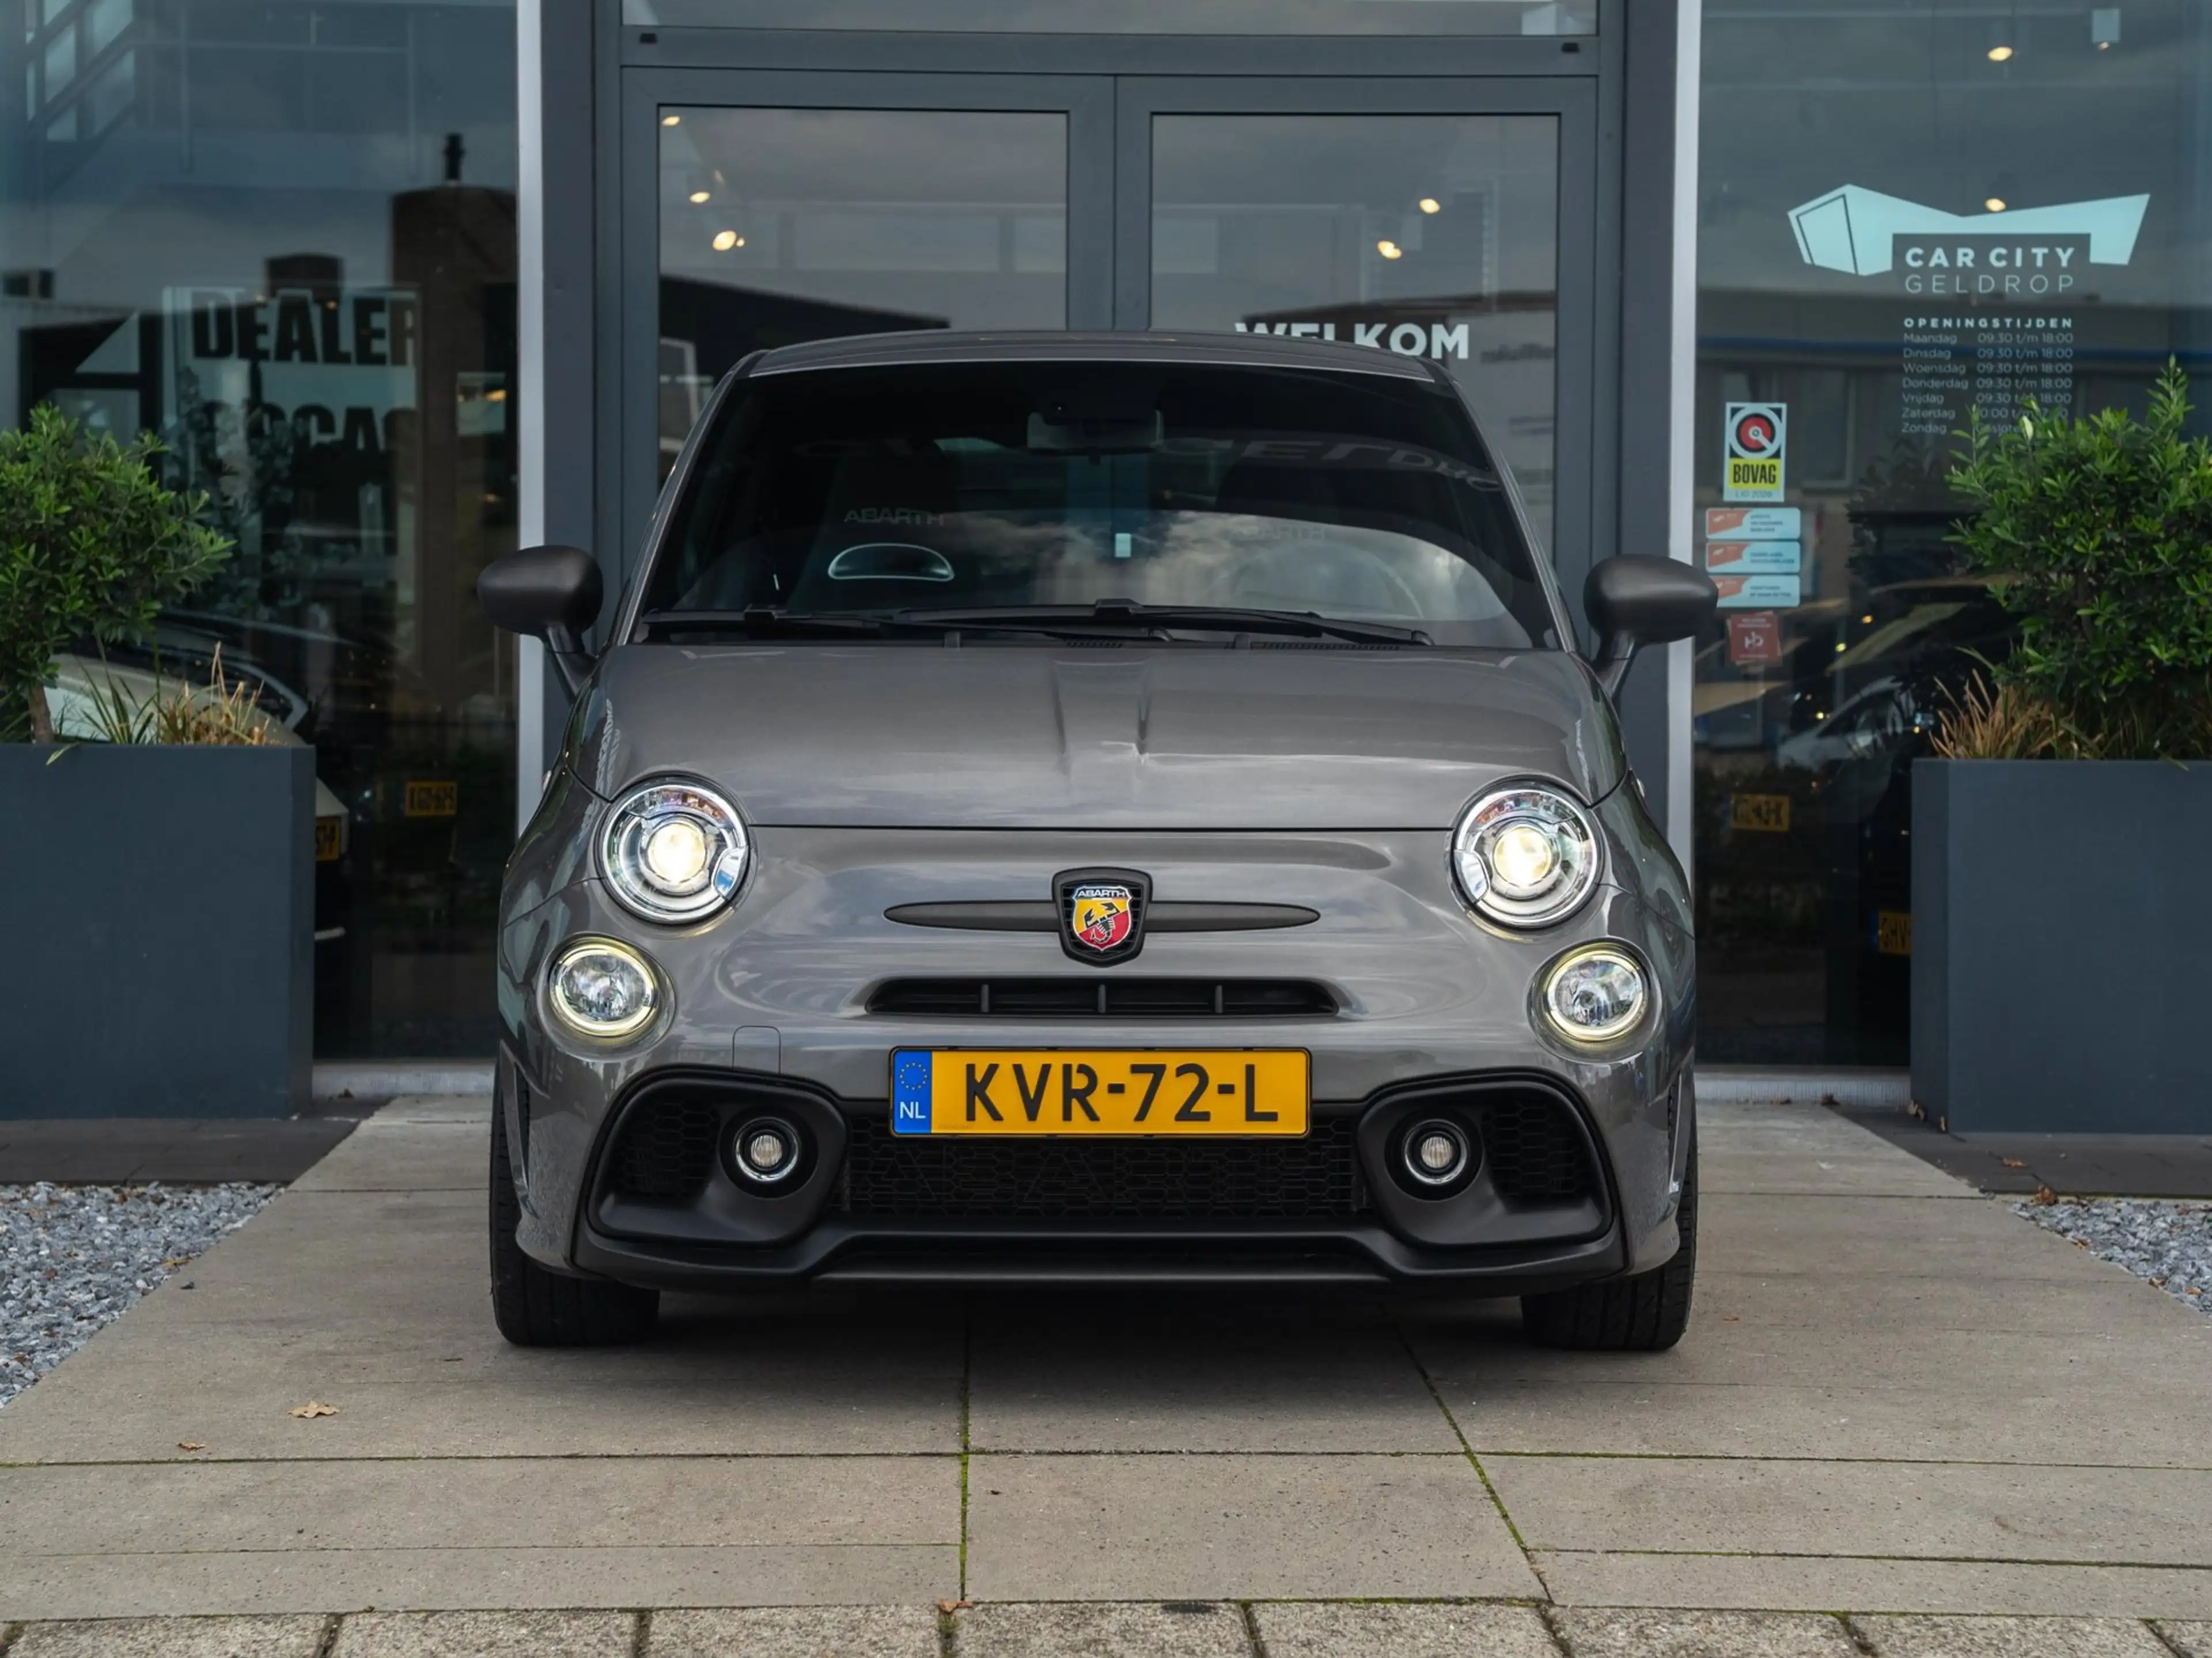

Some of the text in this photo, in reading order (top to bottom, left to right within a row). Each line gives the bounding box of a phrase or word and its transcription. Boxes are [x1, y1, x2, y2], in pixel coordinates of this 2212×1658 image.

[1905, 247, 2074, 268] CAR CITY
[1905, 274, 2074, 293] GELDROP
[1903, 318, 2073, 328] OPENINGSTIJDEN
[1234, 323, 1469, 359] KOM
[1903, 332, 1958, 345] Maandag
[2016, 331, 2039, 344] t/m
[1903, 347, 1952, 360] Dinsdag
[2016, 347, 2038, 359] t/m
[1902, 362, 1966, 376] Woensdag
[2015, 362, 2038, 375] t/m
[1902, 377, 1969, 391] Donderdag
[2014, 377, 2037, 390] t/m
[1902, 392, 1945, 406] Vrijdag
[1902, 407, 1956, 421] Zaterdag
[1901, 422, 1948, 436] Zondag
[1733, 463, 1777, 484] BOVAG
[843, 507, 945, 527] ABARTH
[1077, 889, 1126, 898] ABARTH
[965, 1063, 1278, 1122] KVR-72-L
[899, 1101, 926, 1119] NL
